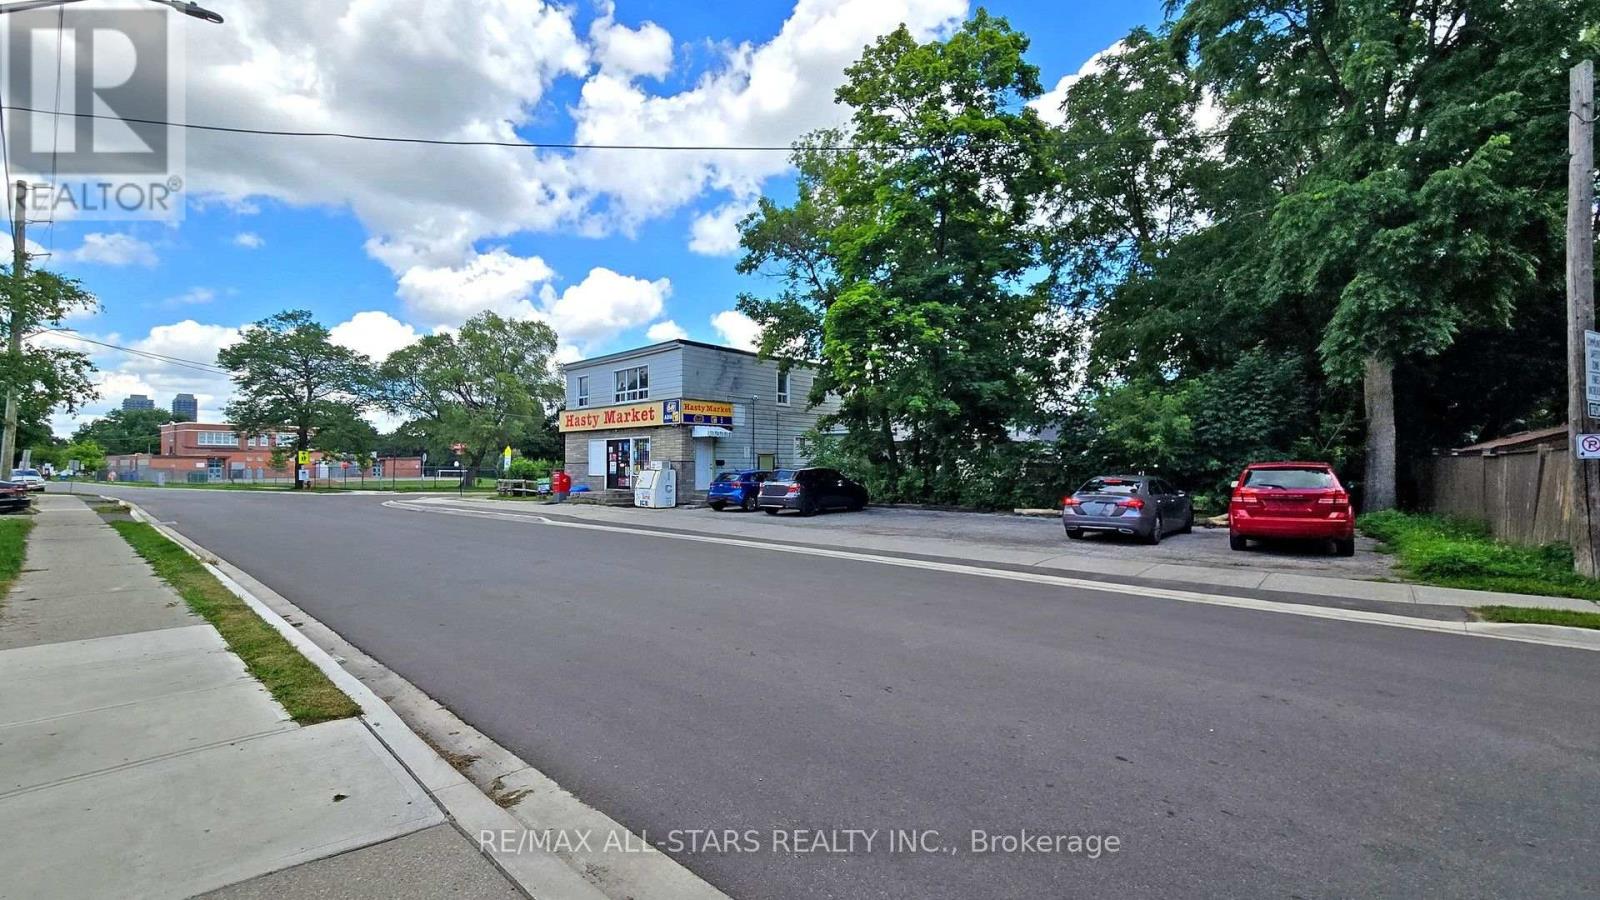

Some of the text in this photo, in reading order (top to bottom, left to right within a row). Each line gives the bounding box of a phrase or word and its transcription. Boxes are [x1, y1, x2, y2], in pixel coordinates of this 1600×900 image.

[684, 403, 732, 413] Hasty Market
[565, 407, 655, 428] Hasty Market
